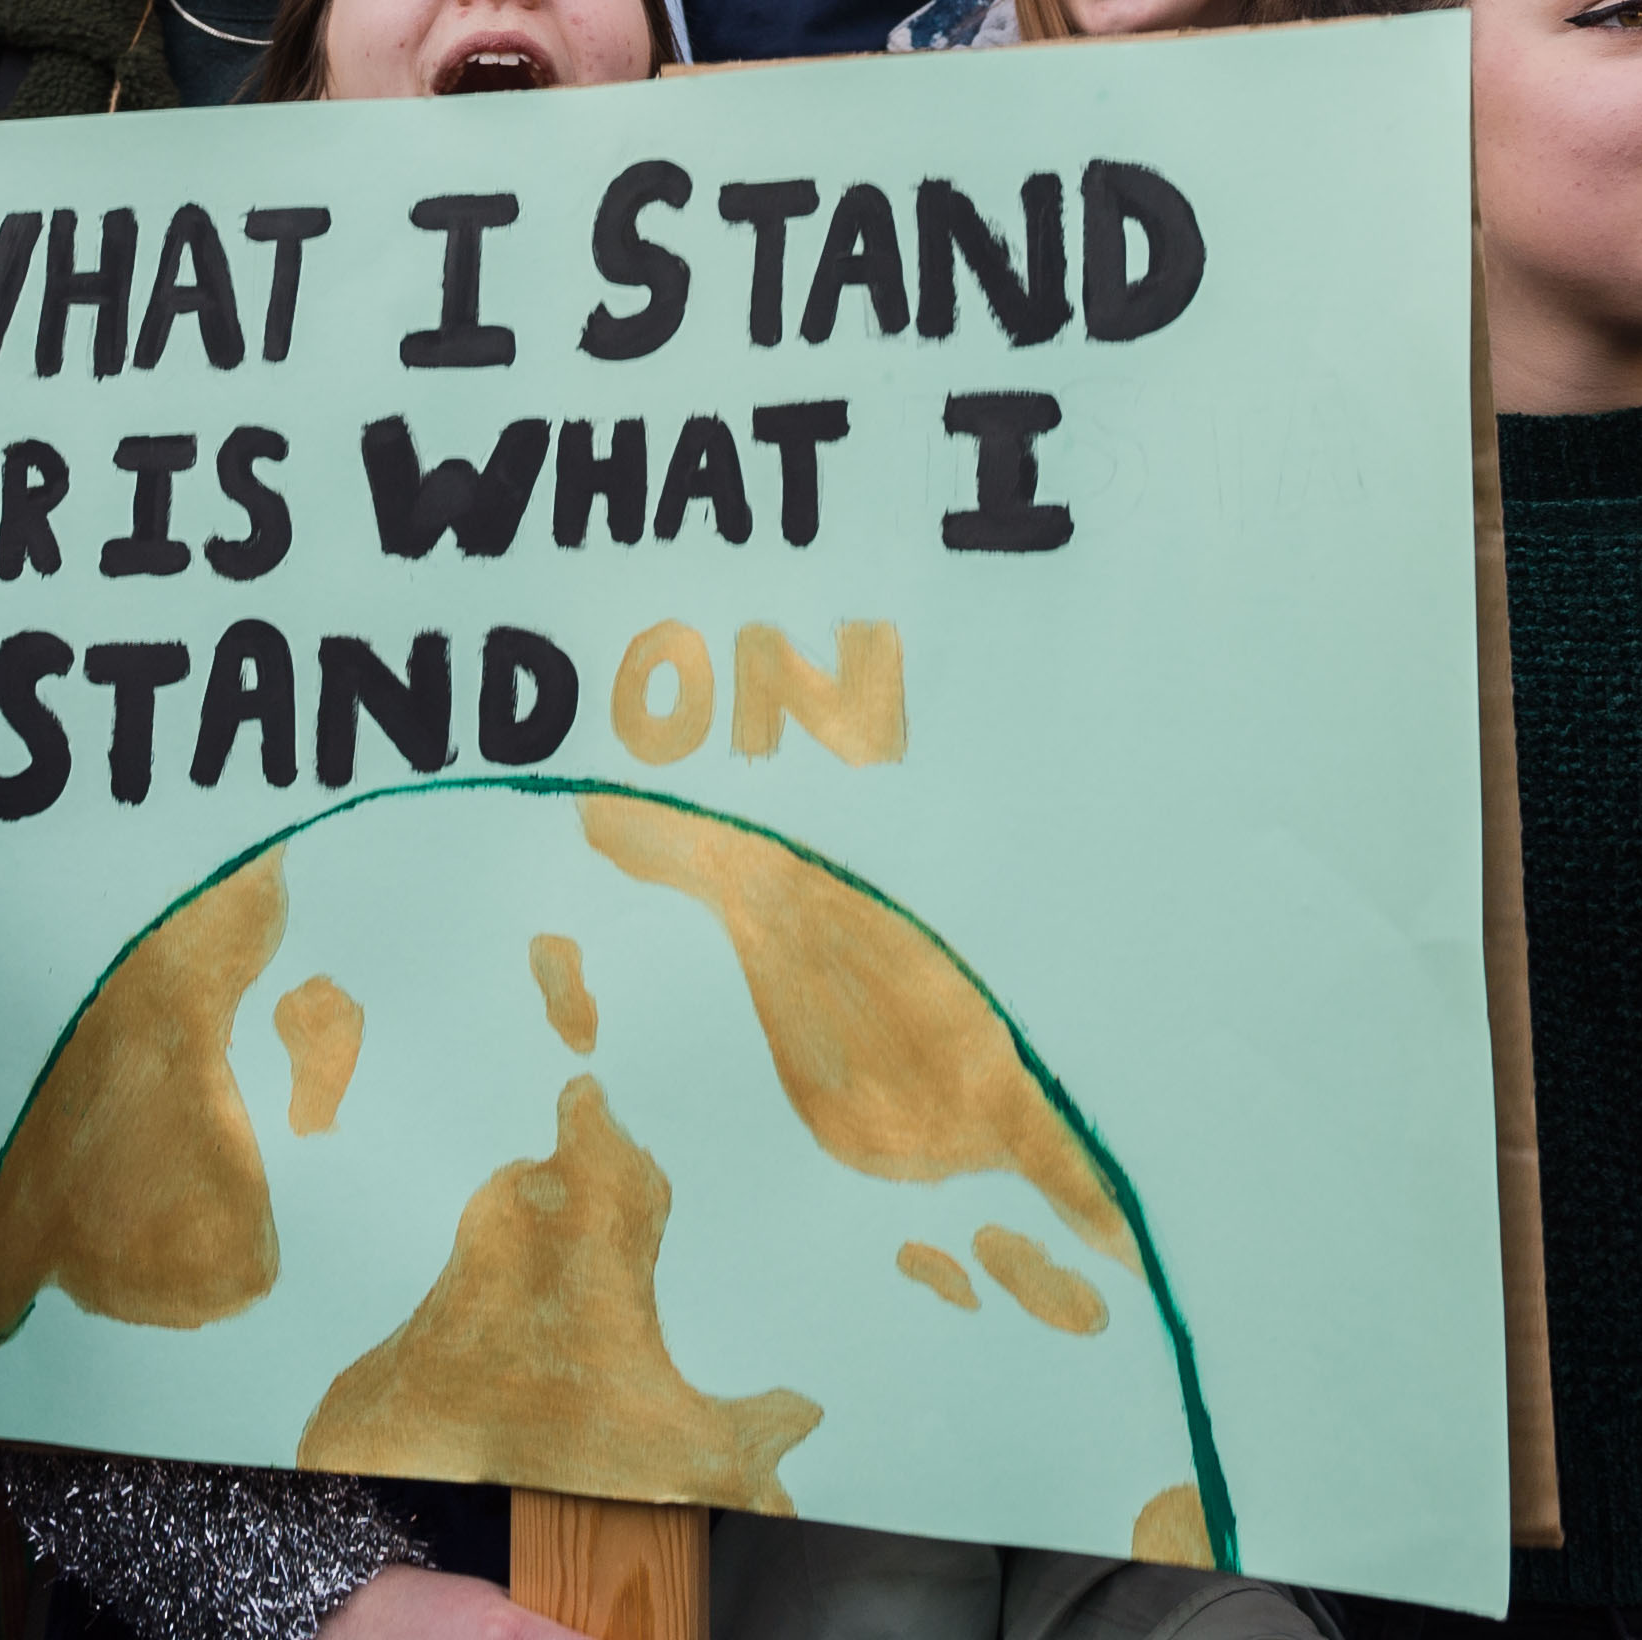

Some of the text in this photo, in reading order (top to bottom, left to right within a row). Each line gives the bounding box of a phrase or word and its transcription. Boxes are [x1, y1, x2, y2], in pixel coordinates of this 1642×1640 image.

[397, 190, 520, 368] I
[578, 157, 1207, 362] STAND
[97, 423, 295, 583] IS
[360, 396, 850, 560] WHAT
[940, 388, 1073, 555] I
[609, 616, 907, 768] ON
